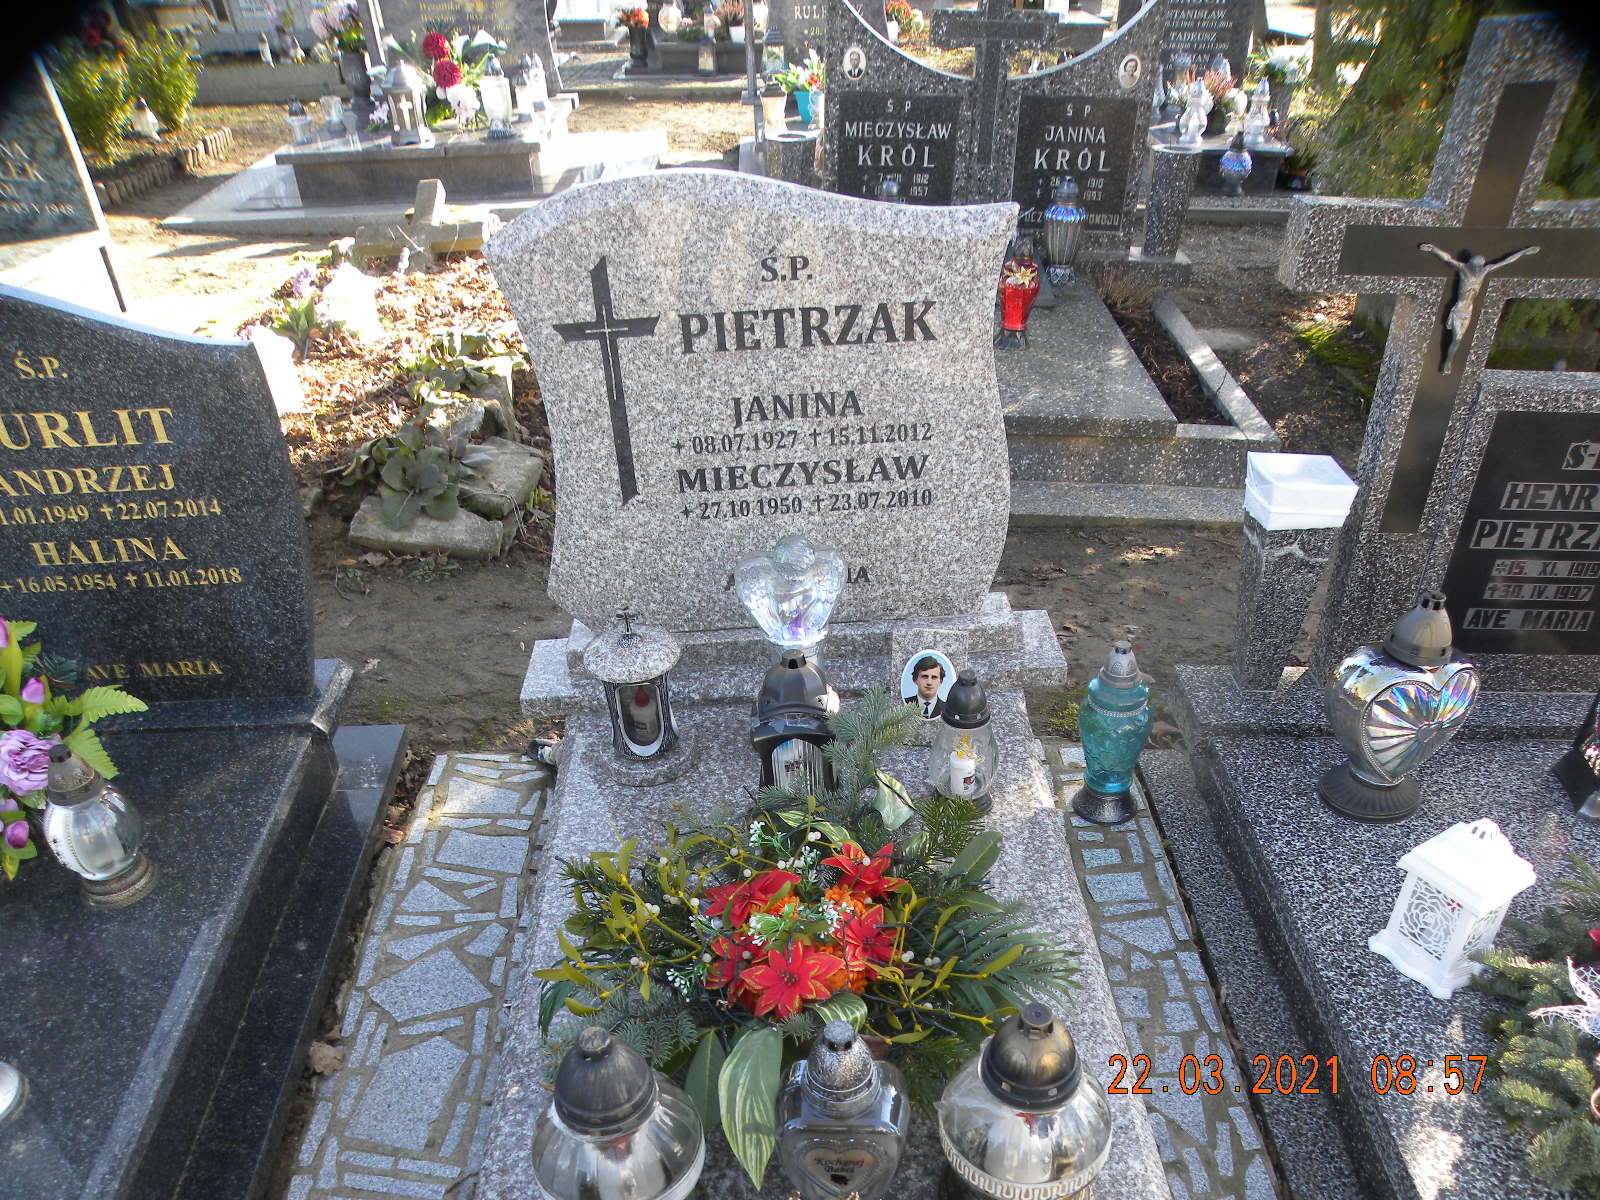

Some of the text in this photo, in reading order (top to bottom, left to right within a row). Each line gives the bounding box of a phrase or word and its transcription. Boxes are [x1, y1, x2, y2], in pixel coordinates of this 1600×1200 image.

[1169, 31, 1218, 42] TADEUSZ
[844, 120, 953, 140] MIECZYSŁAW
[1044, 125, 1107, 144] JANINA
[857, 143, 935, 168] KRÓL
[1033, 147, 1111, 172] KRÓL
[760, 249, 814, 283] Ś.P.
[679, 300, 938, 354] PIETRZAK
[14, 350, 69, 380] Ś.P.
[730, 389, 866, 429] JANINA
[691, 422, 933, 455] 08.07.1927 15.11.2012
[676, 454, 930, 493] MIECZYSŁAW
[117, 498, 222, 520] 22.07.2014
[829, 488, 933, 512] 23.07.2010
[29, 535, 189, 567] HALINA
[16, 566, 243, 593] 16.05.1954 11.01.2018
[1465, 608, 1593, 631] AVE MARIA
[85, 660, 225, 680] AVE MARIA
